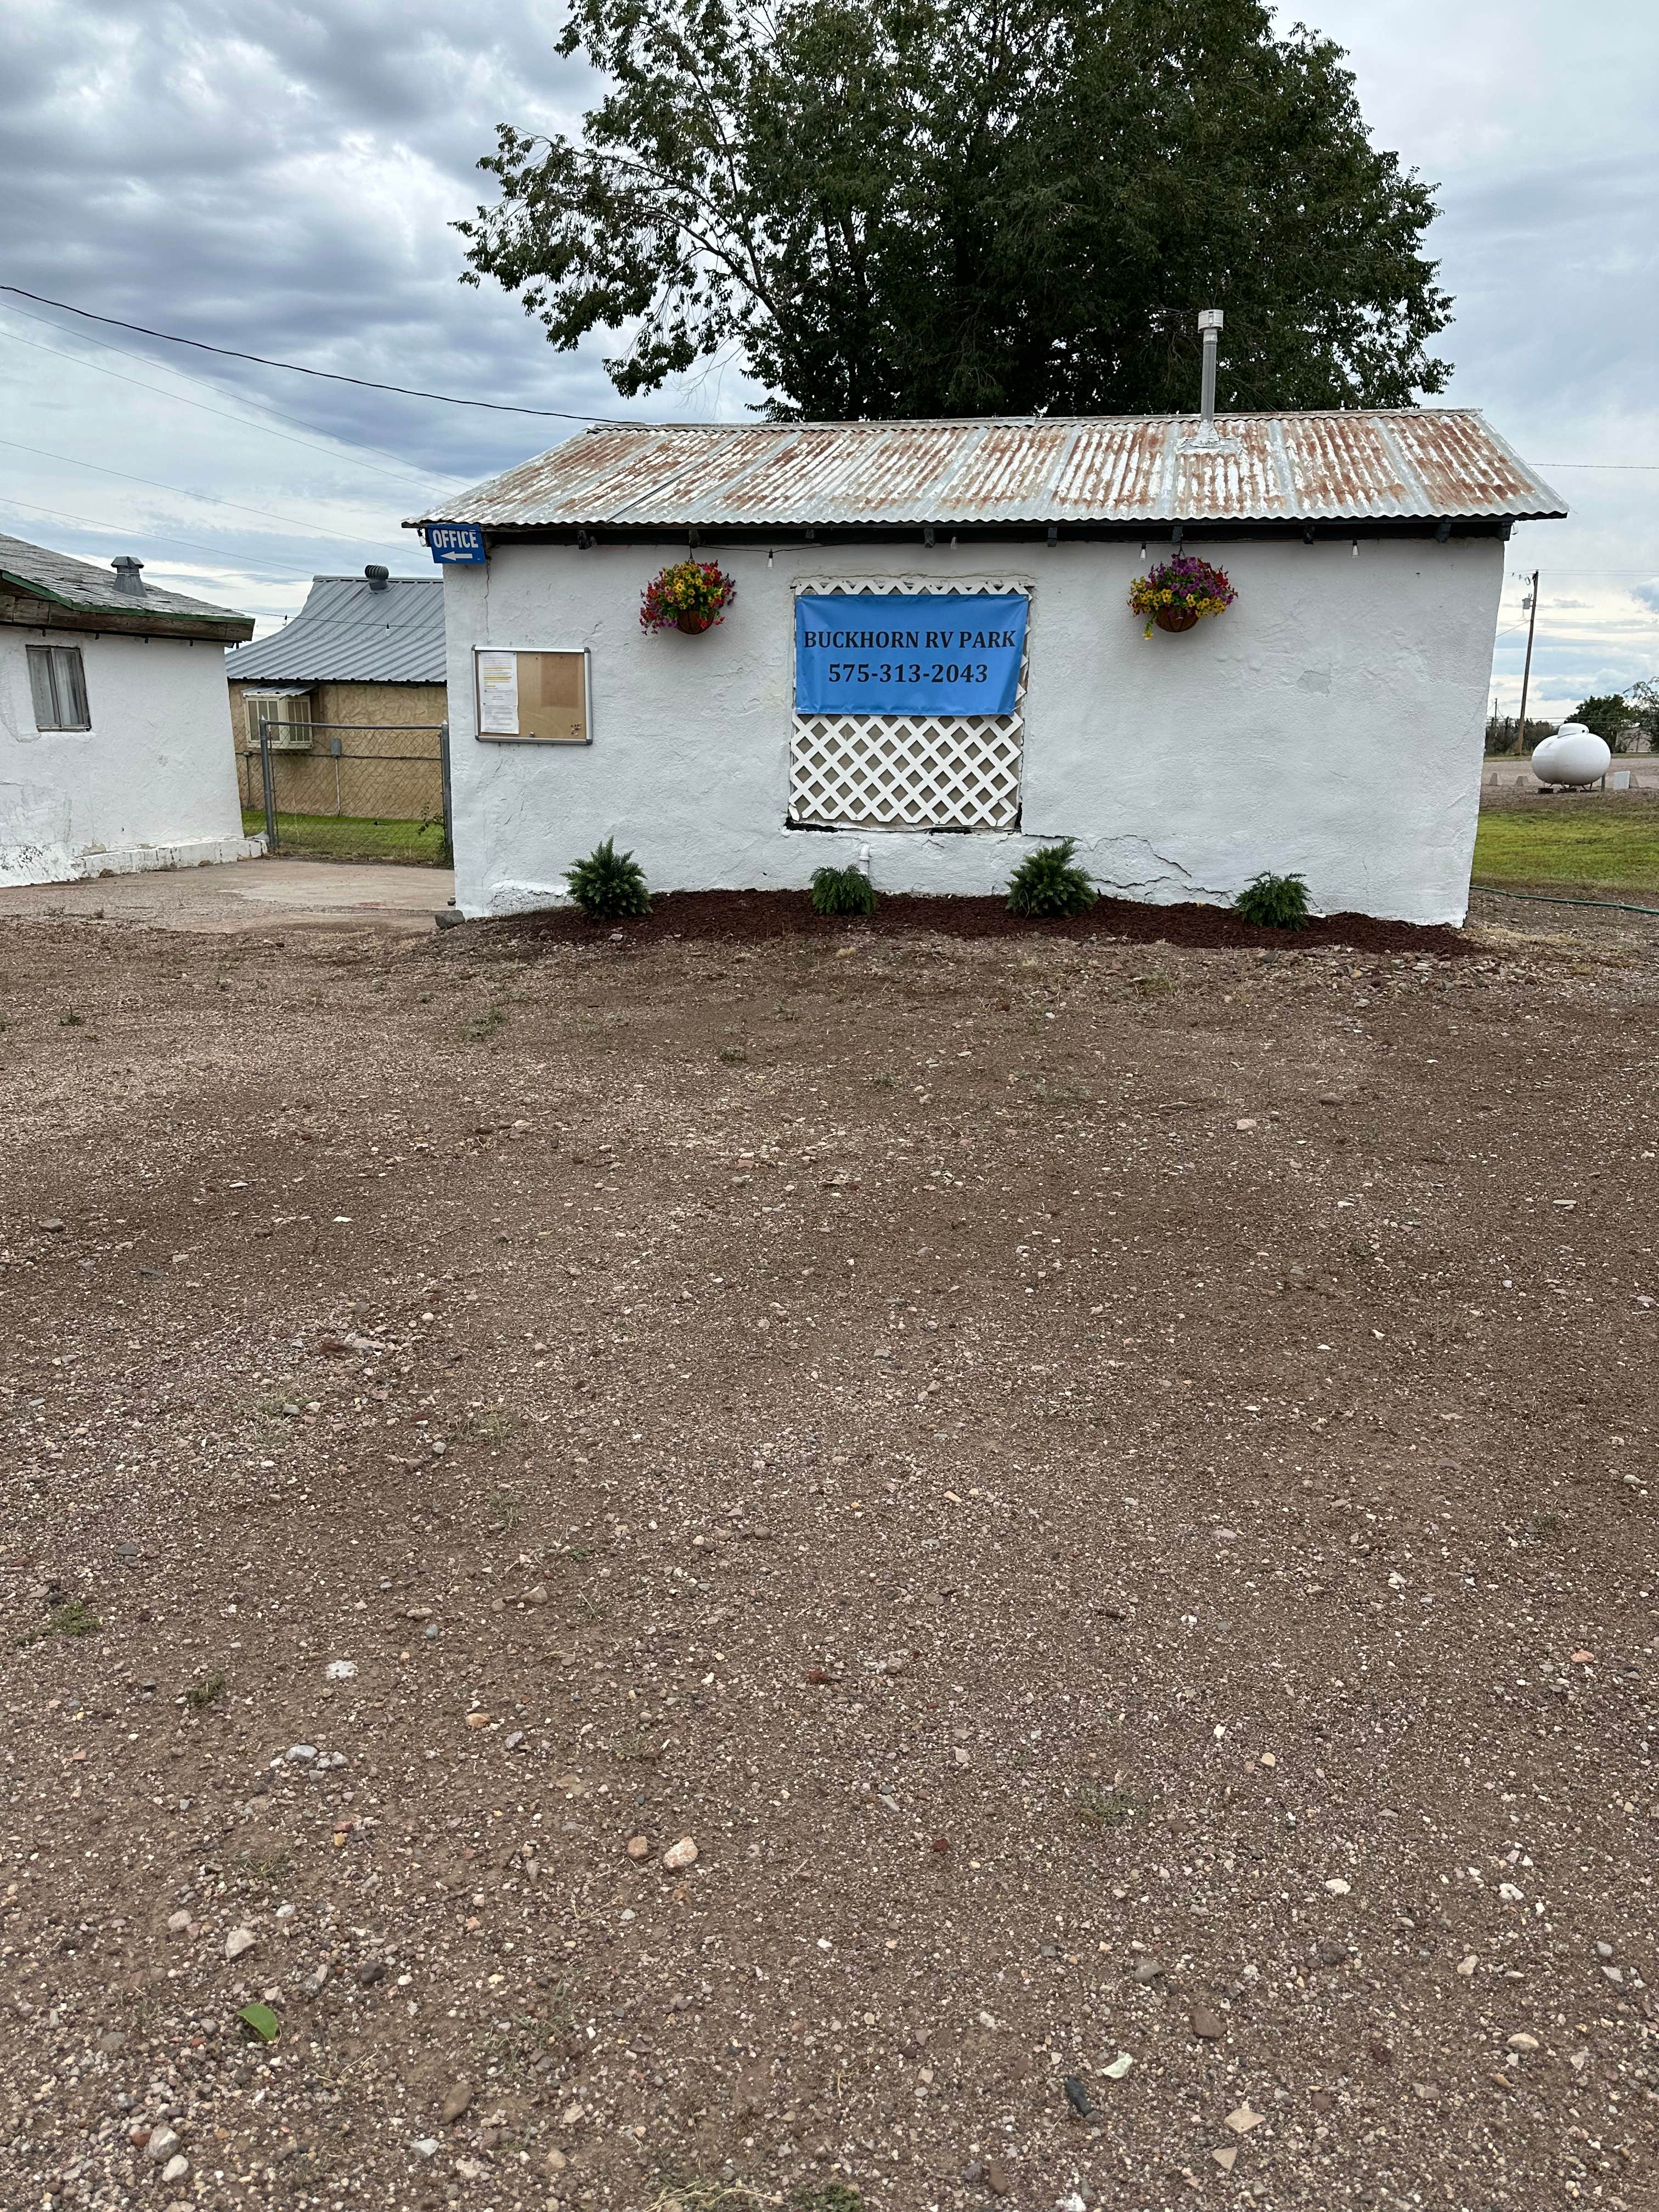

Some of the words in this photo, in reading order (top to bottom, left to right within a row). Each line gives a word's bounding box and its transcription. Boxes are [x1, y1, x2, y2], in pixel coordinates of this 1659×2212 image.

[432, 529, 479, 548] OFFICE
[804, 631, 919, 648] BUCKHORN
[925, 631, 953, 648] RV
[959, 630, 1016, 648] PARK
[828, 663, 988, 683] 575-313-2043
